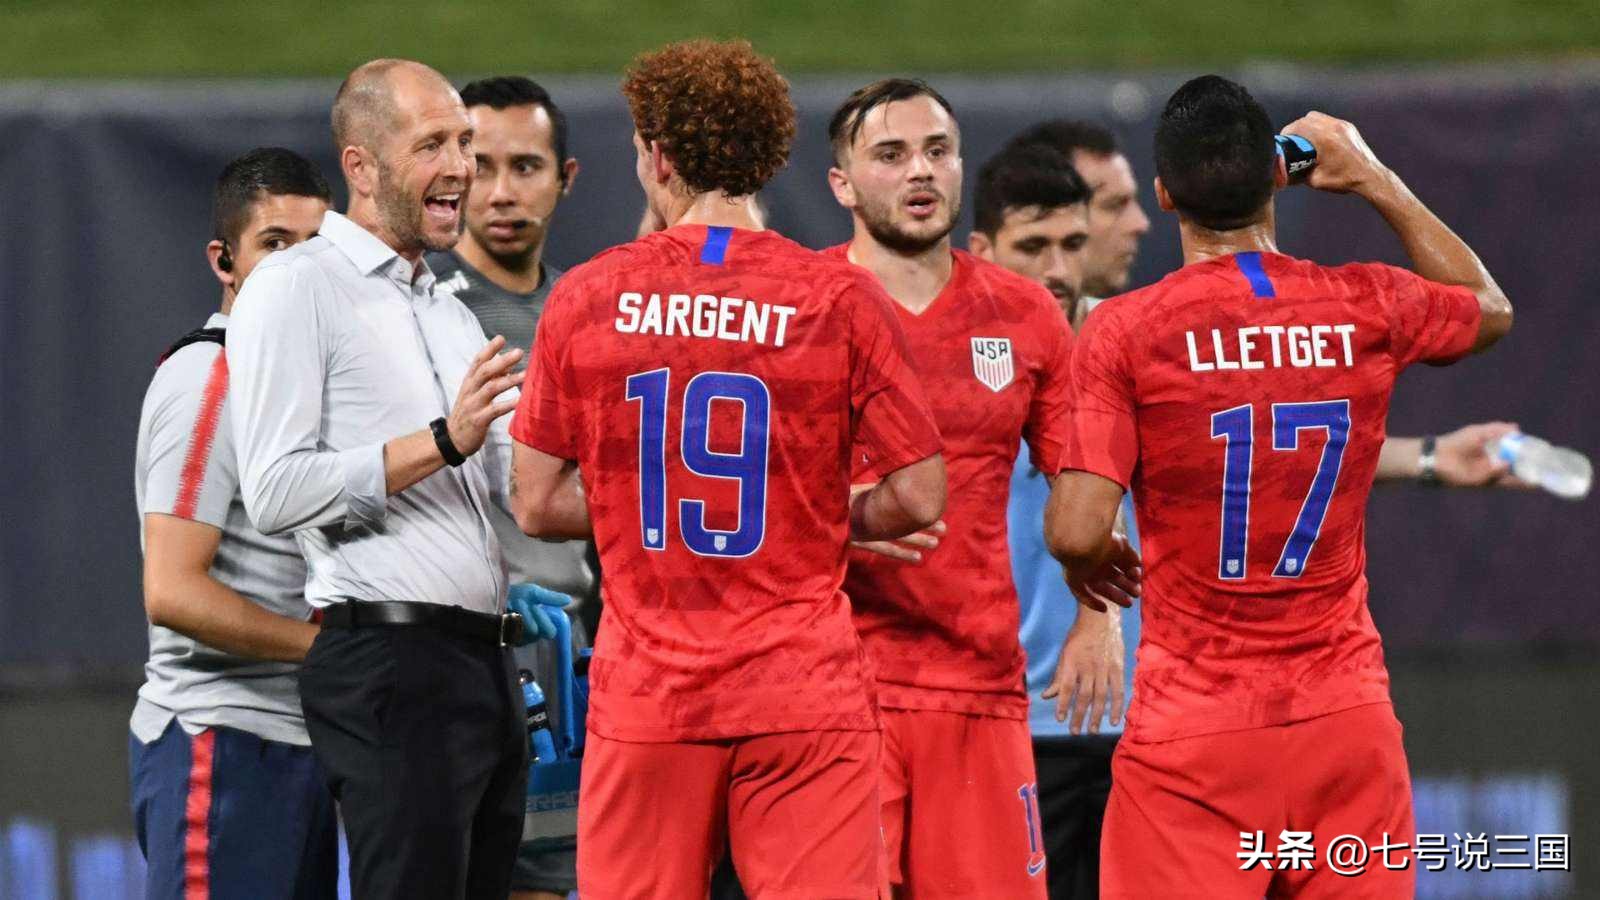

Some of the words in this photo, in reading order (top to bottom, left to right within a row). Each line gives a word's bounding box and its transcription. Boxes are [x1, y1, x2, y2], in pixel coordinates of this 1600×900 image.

[615, 292, 796, 347] SARGENT
[974, 340, 1008, 360] USA
[1186, 324, 1356, 372] LLETGET
[625, 366, 771, 558] 19
[1210, 399, 1351, 580] 17
